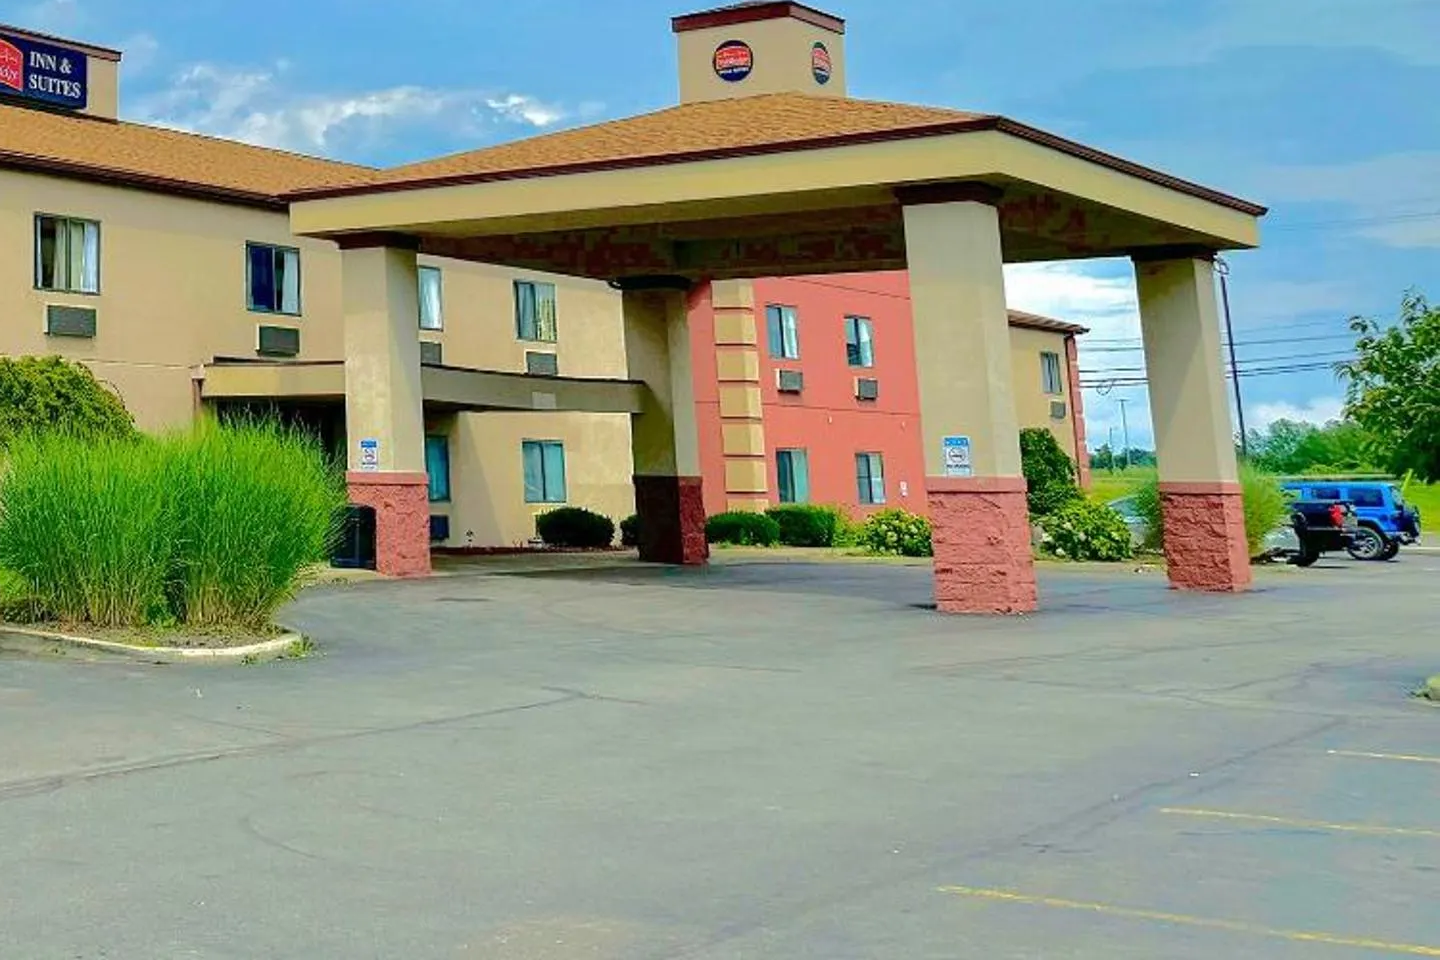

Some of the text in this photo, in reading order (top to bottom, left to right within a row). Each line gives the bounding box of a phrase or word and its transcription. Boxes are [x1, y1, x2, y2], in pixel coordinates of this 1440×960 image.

[29, 51, 72, 74] INN &
[28, 74, 81, 99] SUITES
